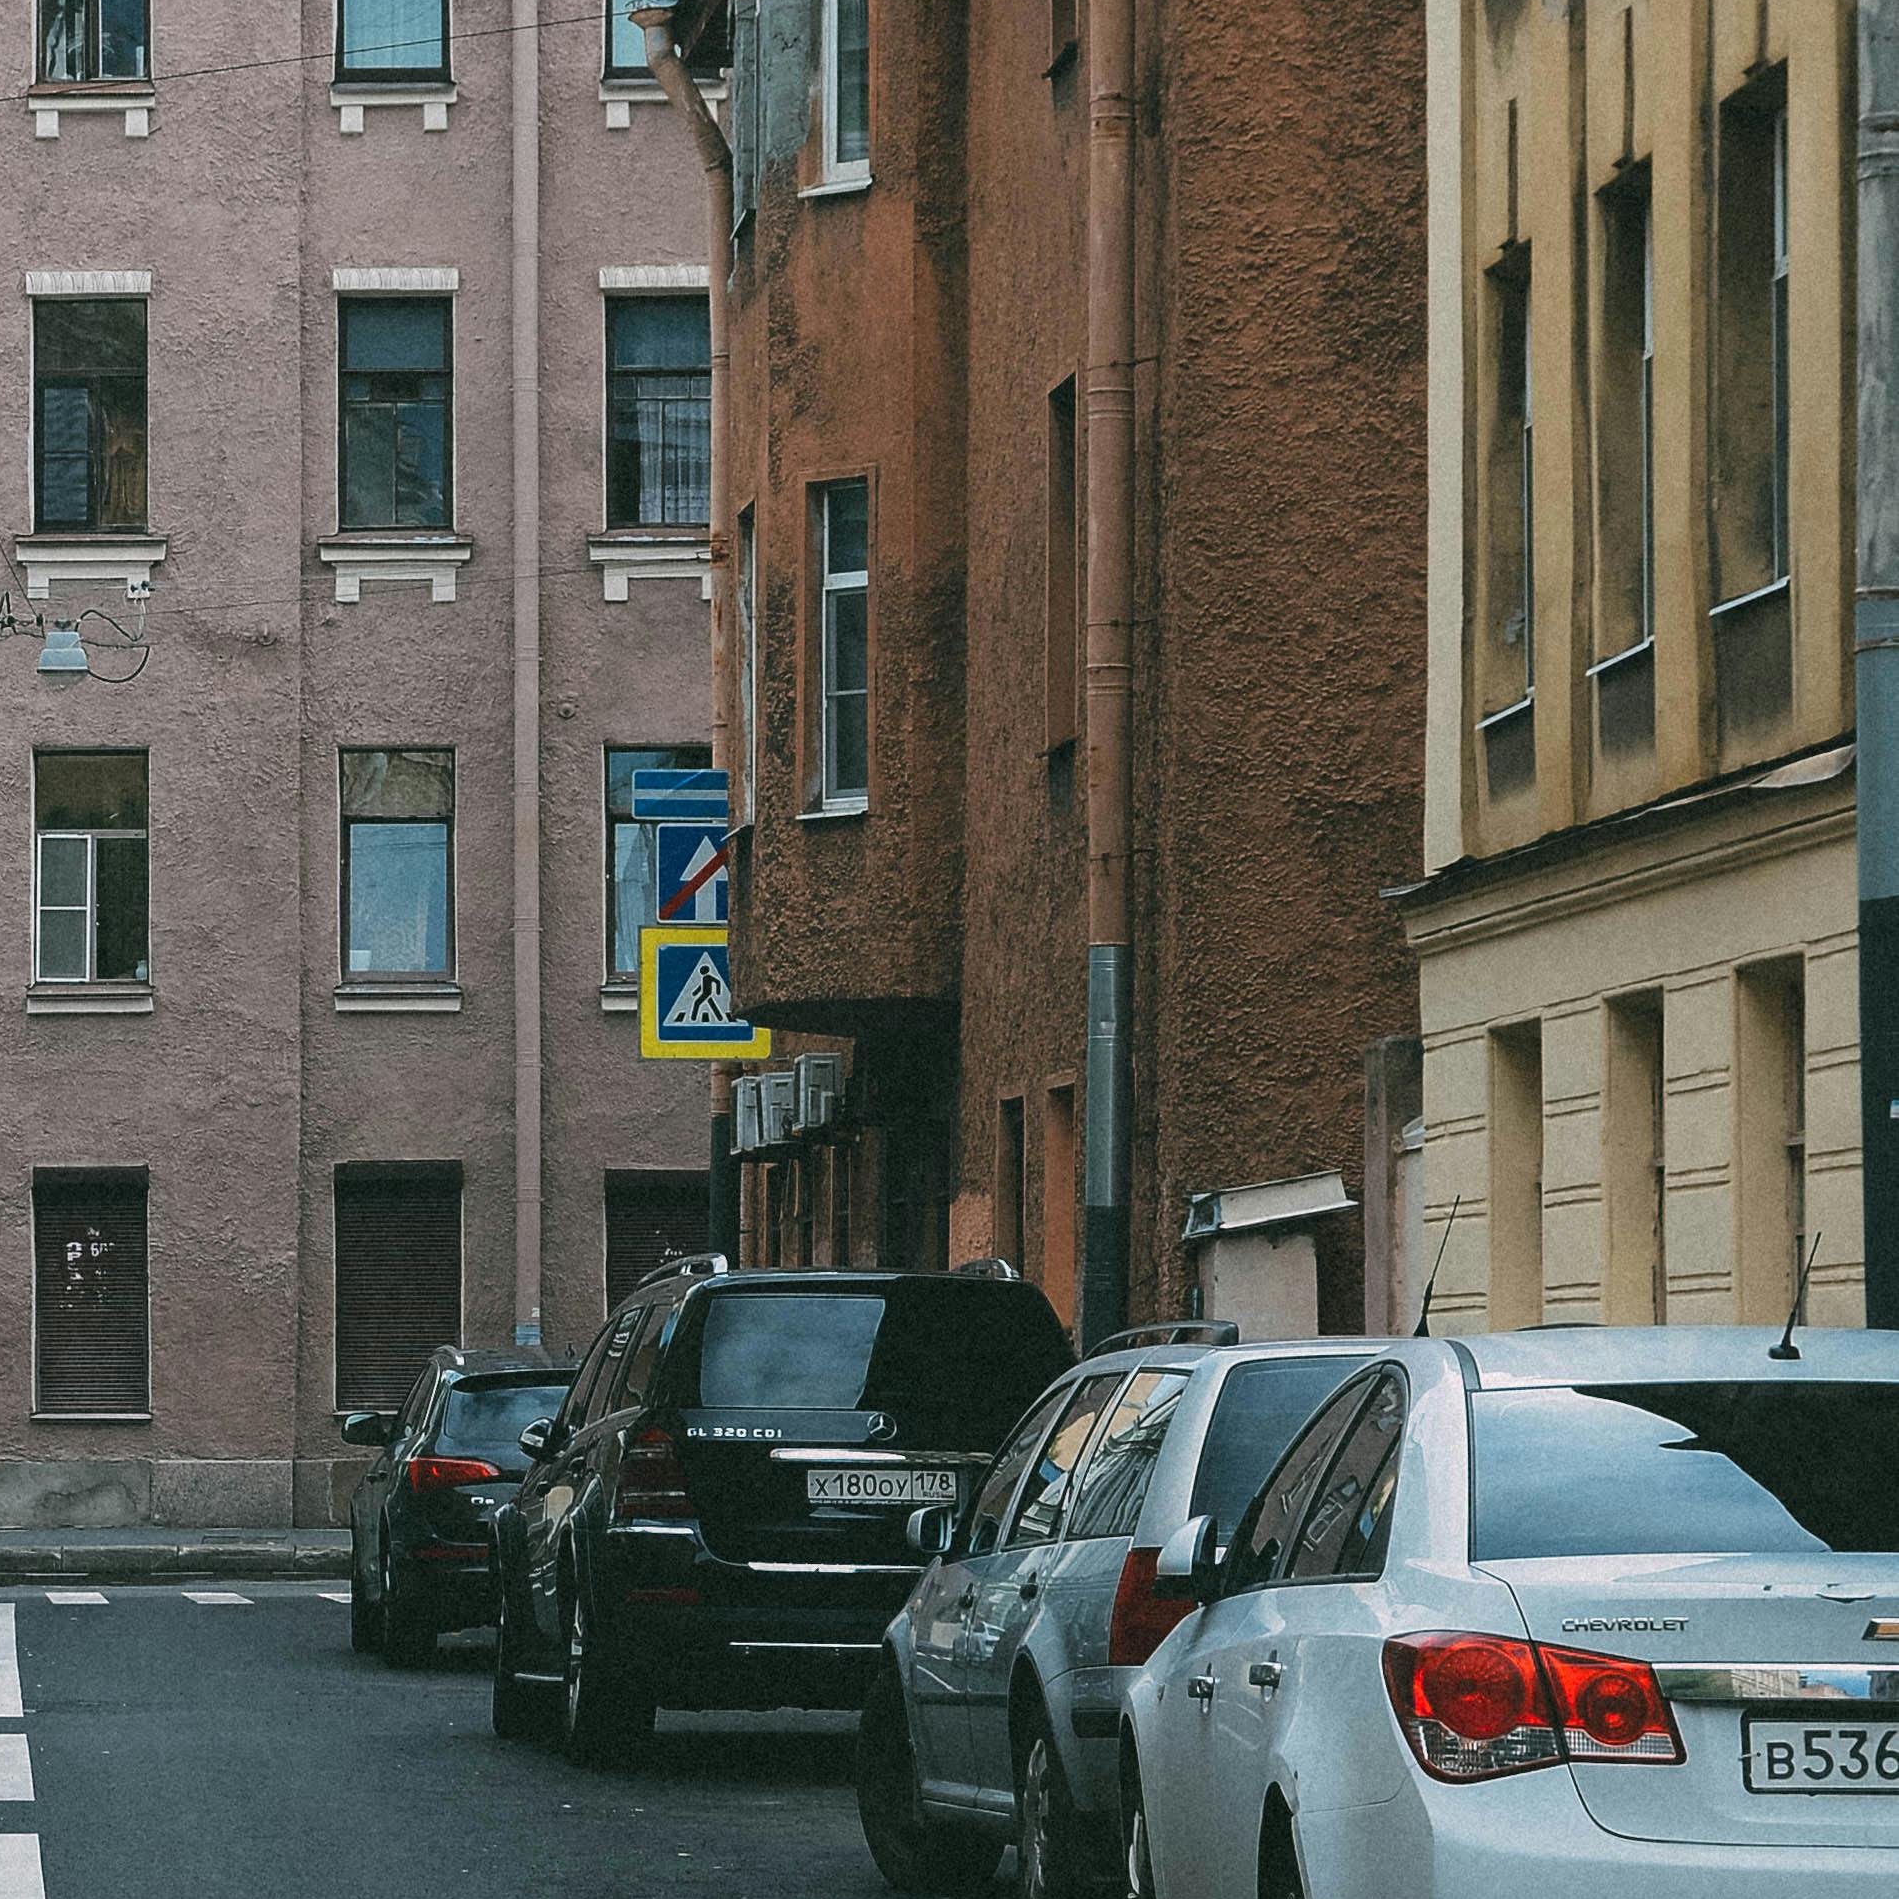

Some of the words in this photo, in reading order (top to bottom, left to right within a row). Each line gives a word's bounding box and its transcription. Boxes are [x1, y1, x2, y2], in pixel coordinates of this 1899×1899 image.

[687, 1427, 707, 1438] GL
[712, 1427, 747, 1438] 320
[753, 1428, 782, 1439] CDI
[915, 1472, 950, 1491] 178
[1561, 1616, 1690, 1632] CHEVROLET
